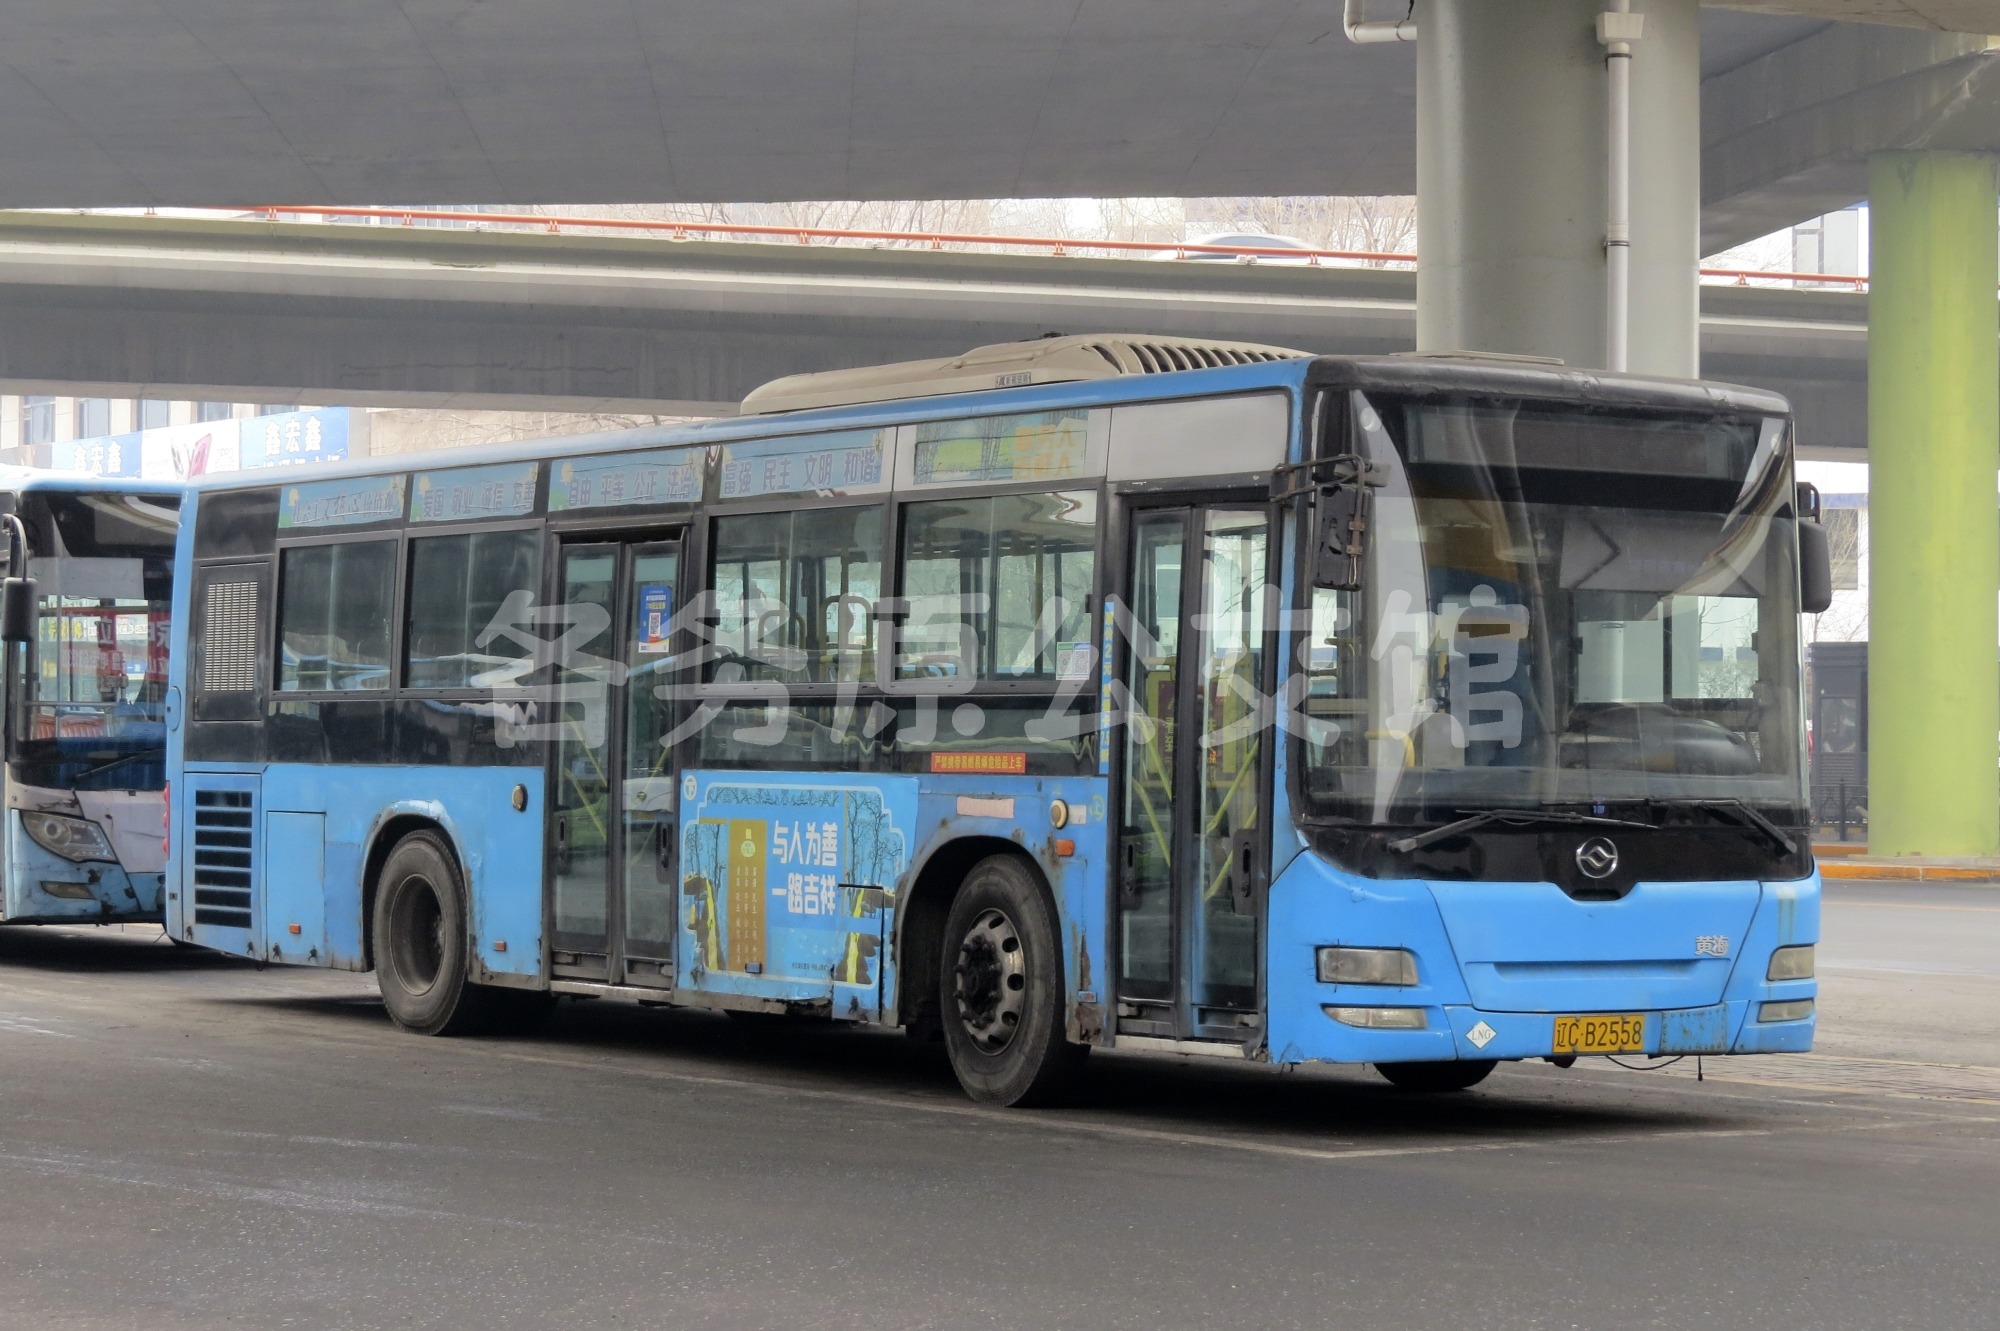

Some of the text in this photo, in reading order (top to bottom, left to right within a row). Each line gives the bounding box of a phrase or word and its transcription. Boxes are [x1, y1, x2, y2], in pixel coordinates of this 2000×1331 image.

[265, 415, 323, 457] 鑫宏鑫
[568, 474, 592, 507] 自由
[601, 472, 625, 504] 平等
[634, 470, 659, 501] 公正
[725, 448, 876, 496] 富强 民主 文明 和谐
[423, 486, 445, 518] 爱国
[934, 754, 1023, 770] 严禁携带易燃易爆危险品上车
[772, 819, 838, 867] 与人为善
[771, 872, 837, 916] 一路吉祥
[1694, 934, 1729, 957] 黄海
[1472, 1028, 1492, 1040] LNG
[1555, 1020, 1642, 1048] 辽C·B2558
